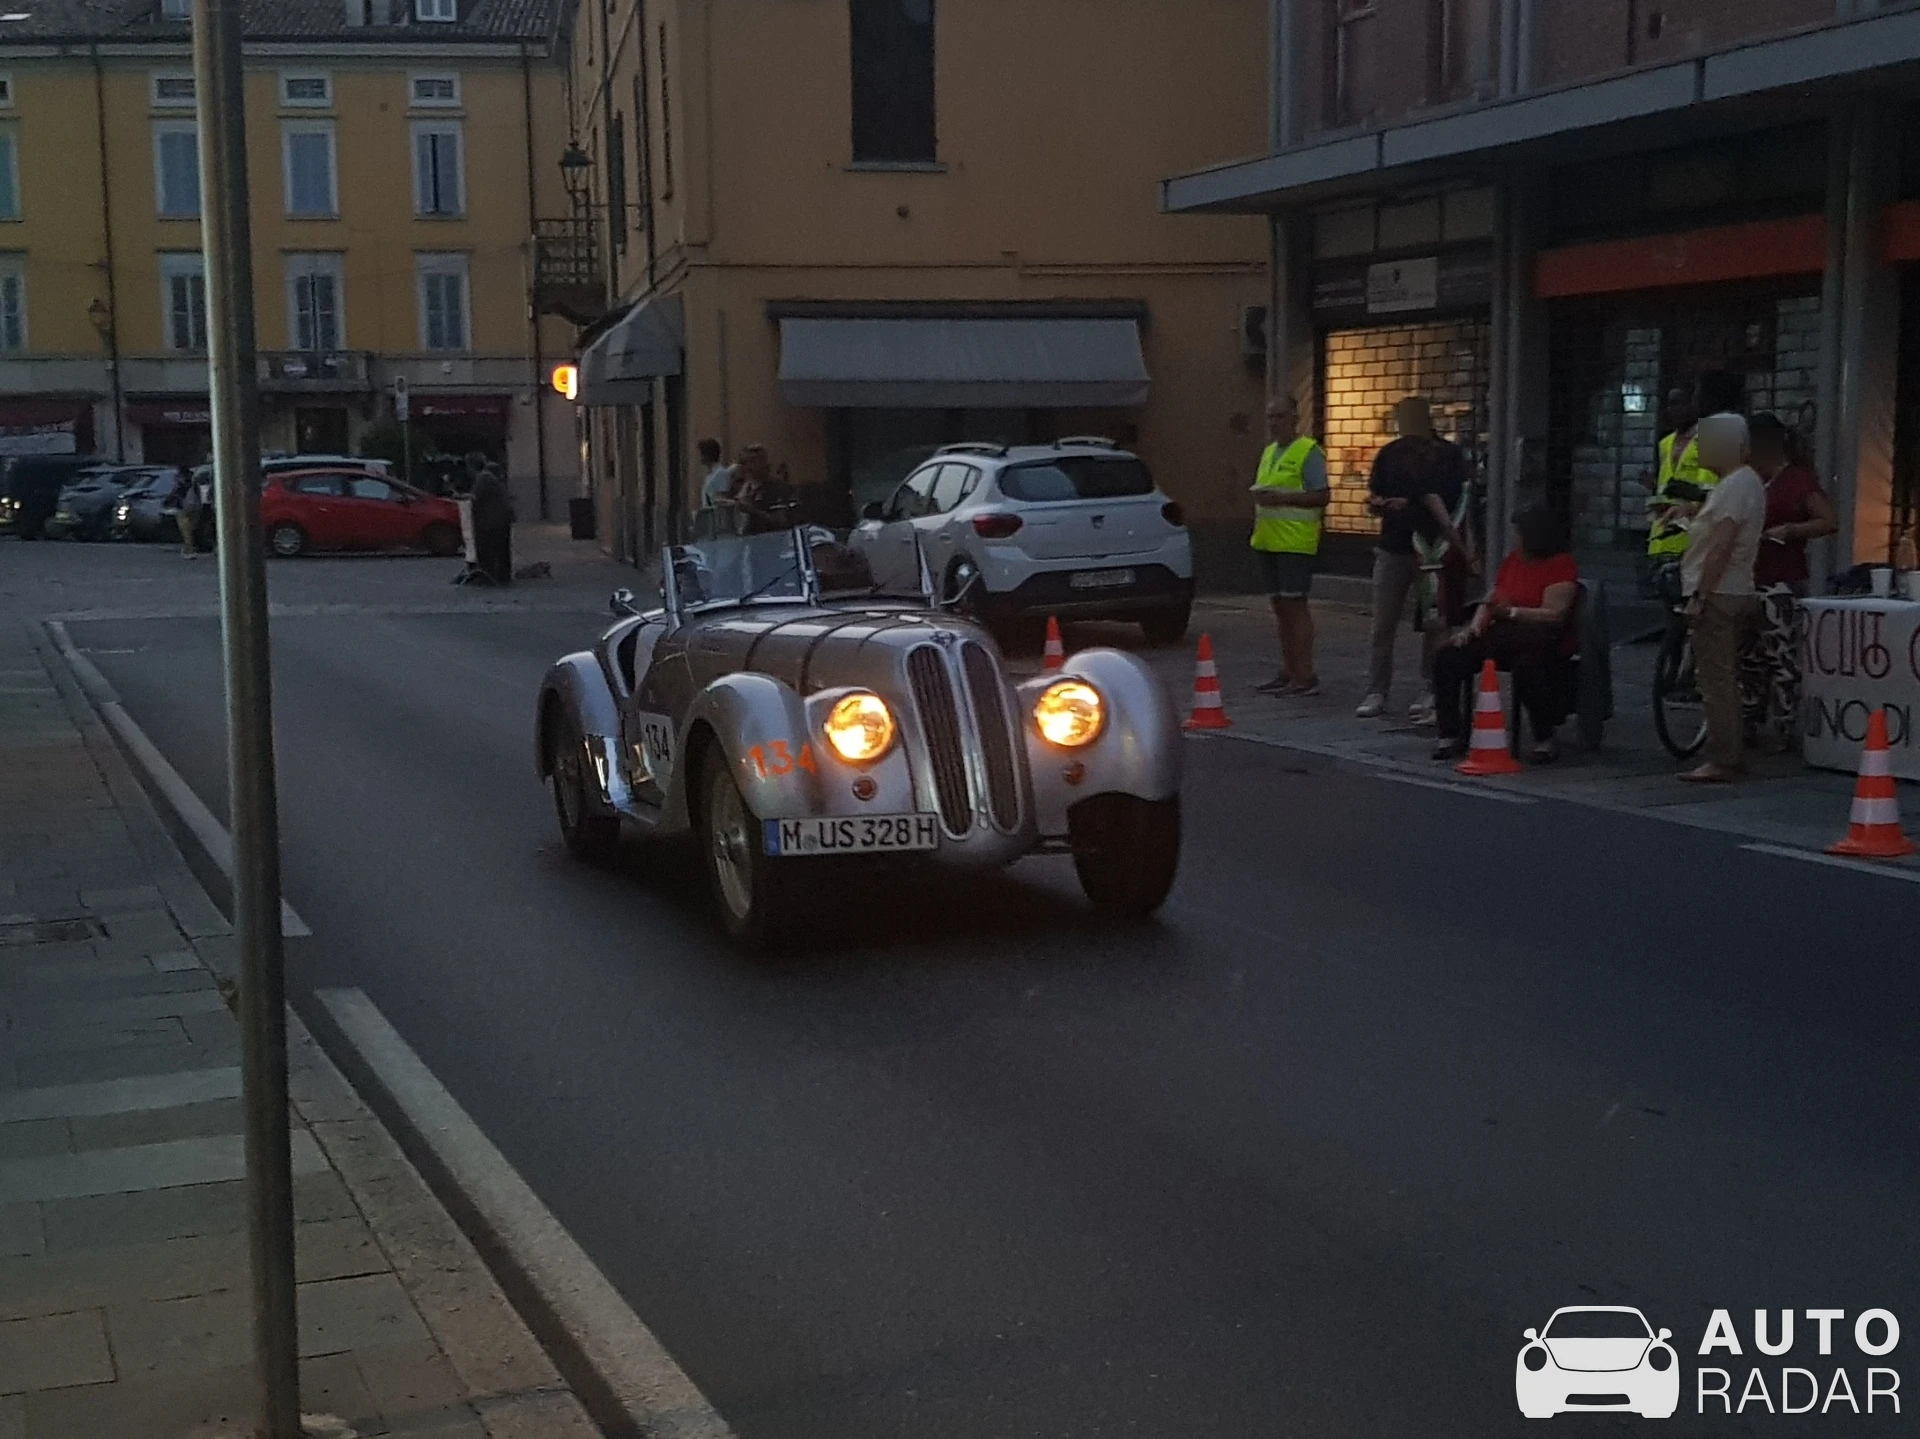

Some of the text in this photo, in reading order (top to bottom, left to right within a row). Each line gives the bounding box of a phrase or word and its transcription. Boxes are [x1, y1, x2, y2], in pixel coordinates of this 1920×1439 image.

[645, 723, 670, 761] 134
[1883, 703, 1910, 748] DI
[749, 740, 816, 777] 134
[783, 821, 802, 851] M
[819, 820, 854, 848] US
